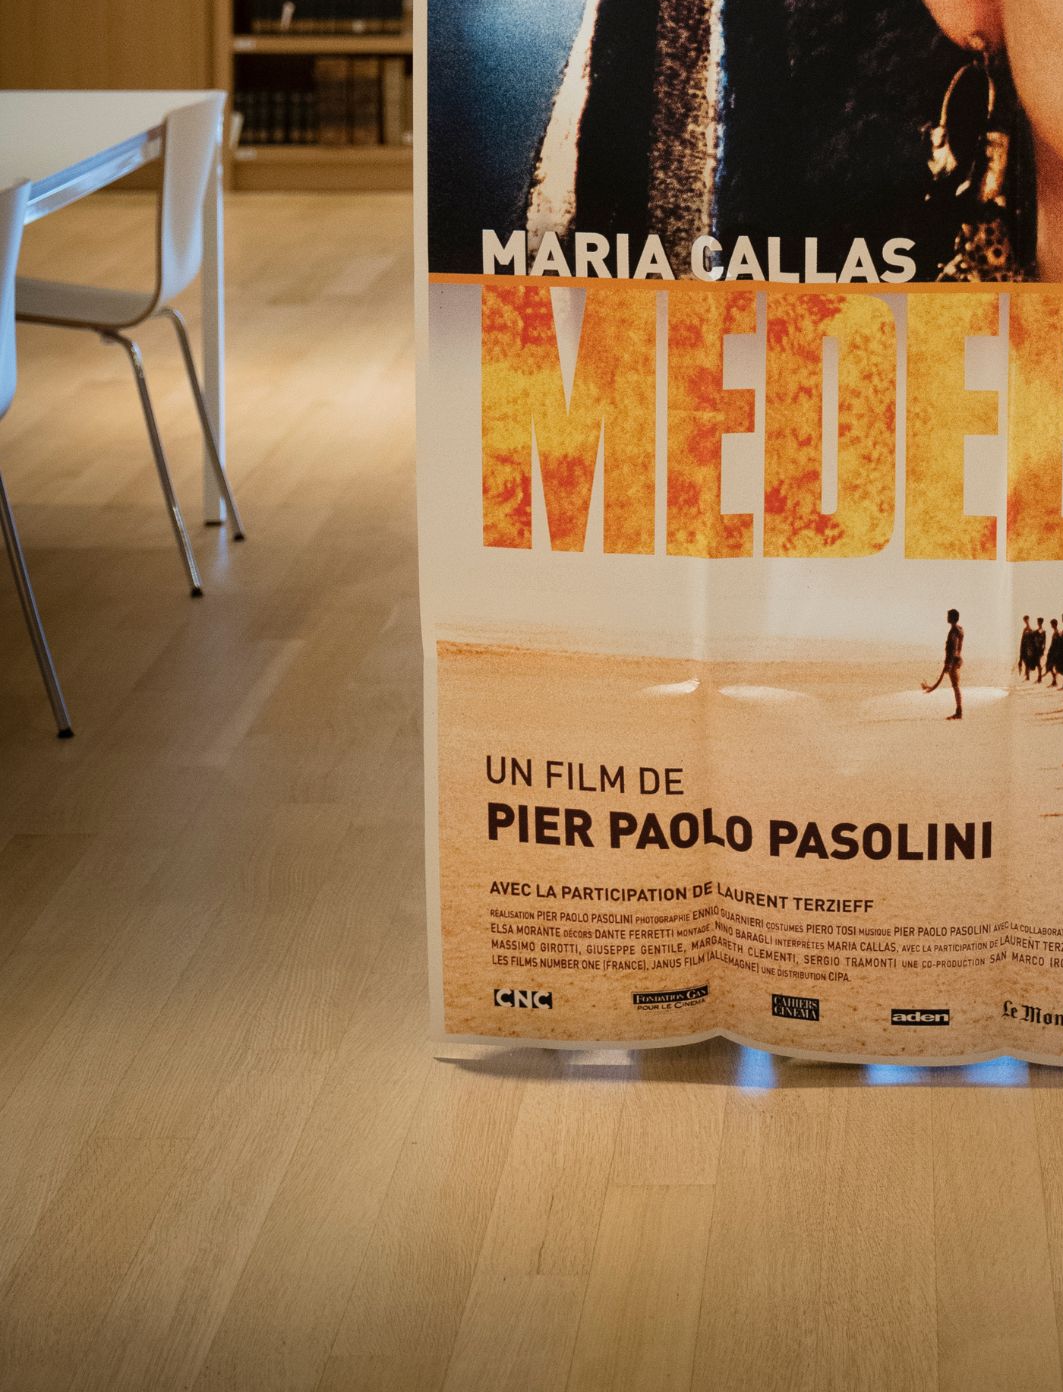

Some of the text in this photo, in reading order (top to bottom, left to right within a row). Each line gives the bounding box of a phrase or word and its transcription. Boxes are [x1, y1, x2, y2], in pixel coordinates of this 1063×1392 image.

[481, 229, 918, 284] MARIA CALLAS
[485, 755, 685, 796] UN FILM DE
[487, 802, 993, 861] PIER PAOLO PASOLINI
[490, 881, 874, 913] AVEC LA PARTICIPATION DE LAURENT TERZIEFF
[490, 907, 535, 920] RÉALISATION
[537, 910, 558, 922] PIER
[560, 912, 589, 923] PAOLO
[591, 913, 633, 924] PASOLINI
[635, 913, 690, 925] PHOTOGRAPHIE
[692, 905, 719, 921] ENNIO
[720, 908, 764, 928] GUARNIERI
[765, 921, 804, 933] COSTUMES
[806, 923, 834, 935] PIERO
[836, 925, 857, 936] TOSI
[858, 928, 892, 937] MUSIQUE
[894, 926, 915, 937] PIER
[917, 926, 948, 937] PAOLO
[950, 923, 992, 937] PASOLINI
[993, 921, 1009, 932] AVEC
[1010, 922, 1019, 931] LA
[490, 923, 514, 935] ELSA
[516, 925, 561, 938] MORANTE
[563, 928, 593, 939] DÉCORS
[594, 929, 626, 940] DANTE
[629, 929, 674, 940] FERRETTI
[676, 923, 711, 937] MONTAGE
[714, 920, 734, 936] NINO
[735, 928, 773, 945] BARAGLI
[827, 940, 858, 951] MARIA
[860, 941, 899, 953] CALLAS,
[901, 945, 921, 953] AVEC
[922, 945, 932, 953] LA
[933, 942, 988, 953] PARTICIPATION
[989, 939, 999, 949] DE
[1000, 935, 1041, 950] LAURENT
[491, 939, 536, 952] MASSIMO
[540, 942, 582, 956] GIROTTI,
[586, 944, 636, 955] GIUSEPPE
[640, 942, 686, 955] GENTILE,
[691, 935, 743, 954] MARGARETH
[747, 946, 799, 965] CLEMENTI,
[803, 954, 840, 966] SERGIO
[845, 956, 897, 968] TRAMONTI
[901, 960, 918, 968] UNE
[921, 958, 986, 969] CO-PRODUCTION
[989, 950, 1007, 964] SAN
[1011, 951, 1045, 966] MARCO
[492, 954, 509, 966] LES
[510, 955, 538, 968] FILMS
[539, 957, 580, 969] NUMBER
[581, 959, 601, 970] ONE
[651, 957, 682, 970] JANUS
[684, 953, 705, 967] FILM
[761, 967, 776, 976] UNE
[777, 968, 826, 981] DISTRIBUTION
[495, 989, 552, 1009] CNC
[773, 996, 818, 1010] CAHIERS
[1001, 999, 1018, 1019] Le
[892, 1012, 949, 1023] aden
